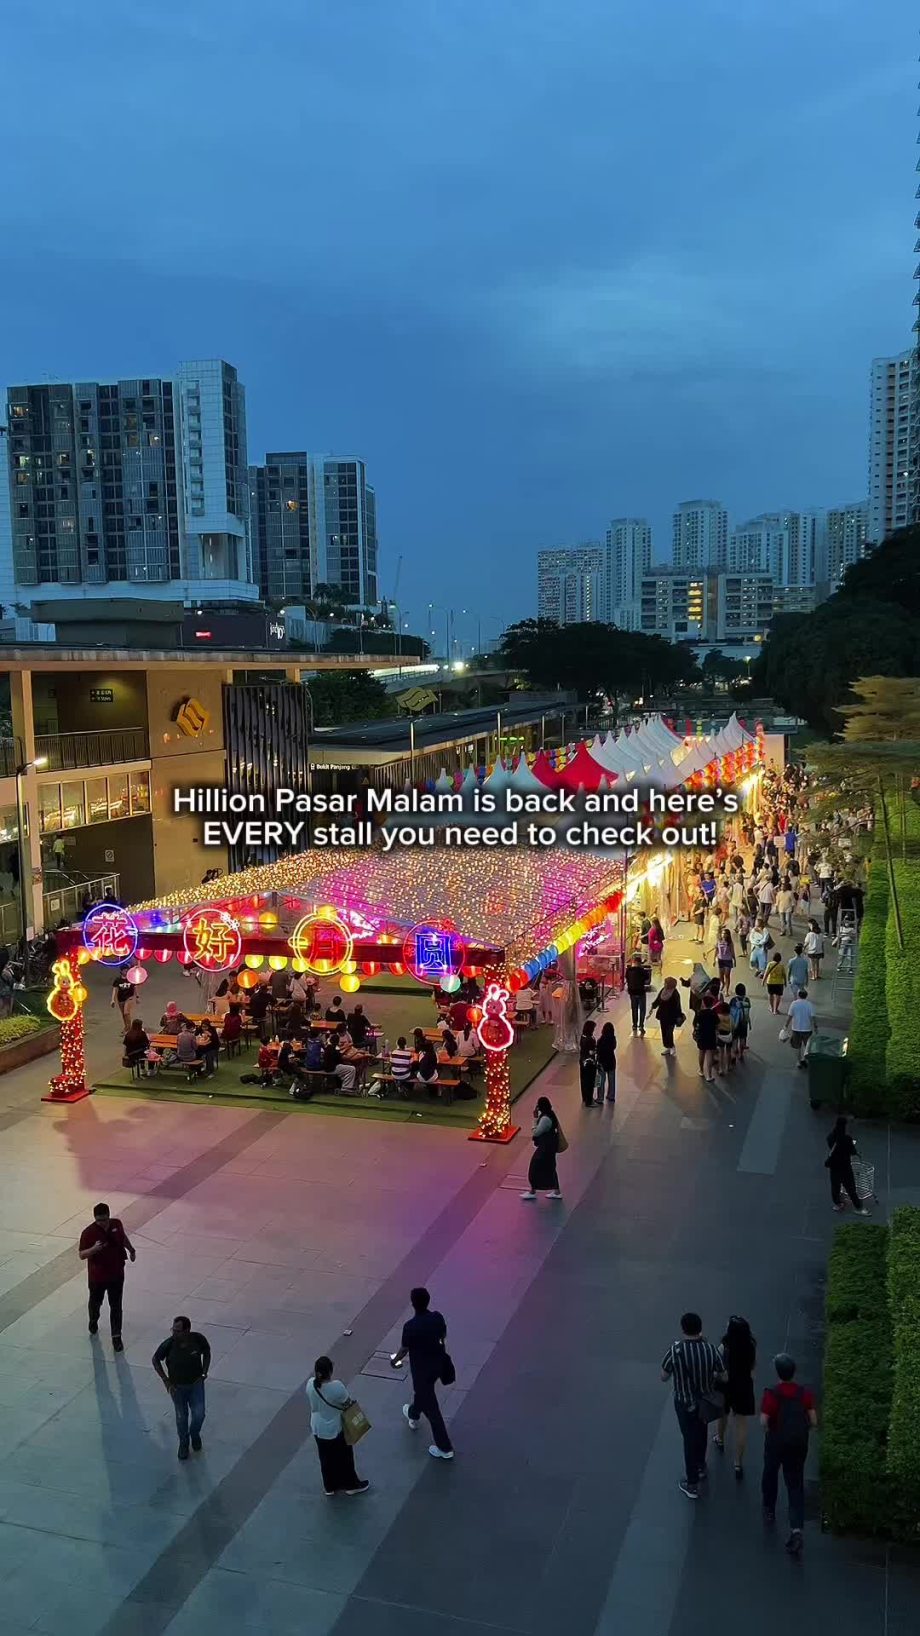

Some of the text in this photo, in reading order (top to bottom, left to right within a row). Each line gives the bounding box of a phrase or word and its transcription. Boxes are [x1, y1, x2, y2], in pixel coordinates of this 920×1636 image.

[90, 911, 131, 957] 花
[193, 917, 235, 963] 好
[308, 922, 341, 967] 月
